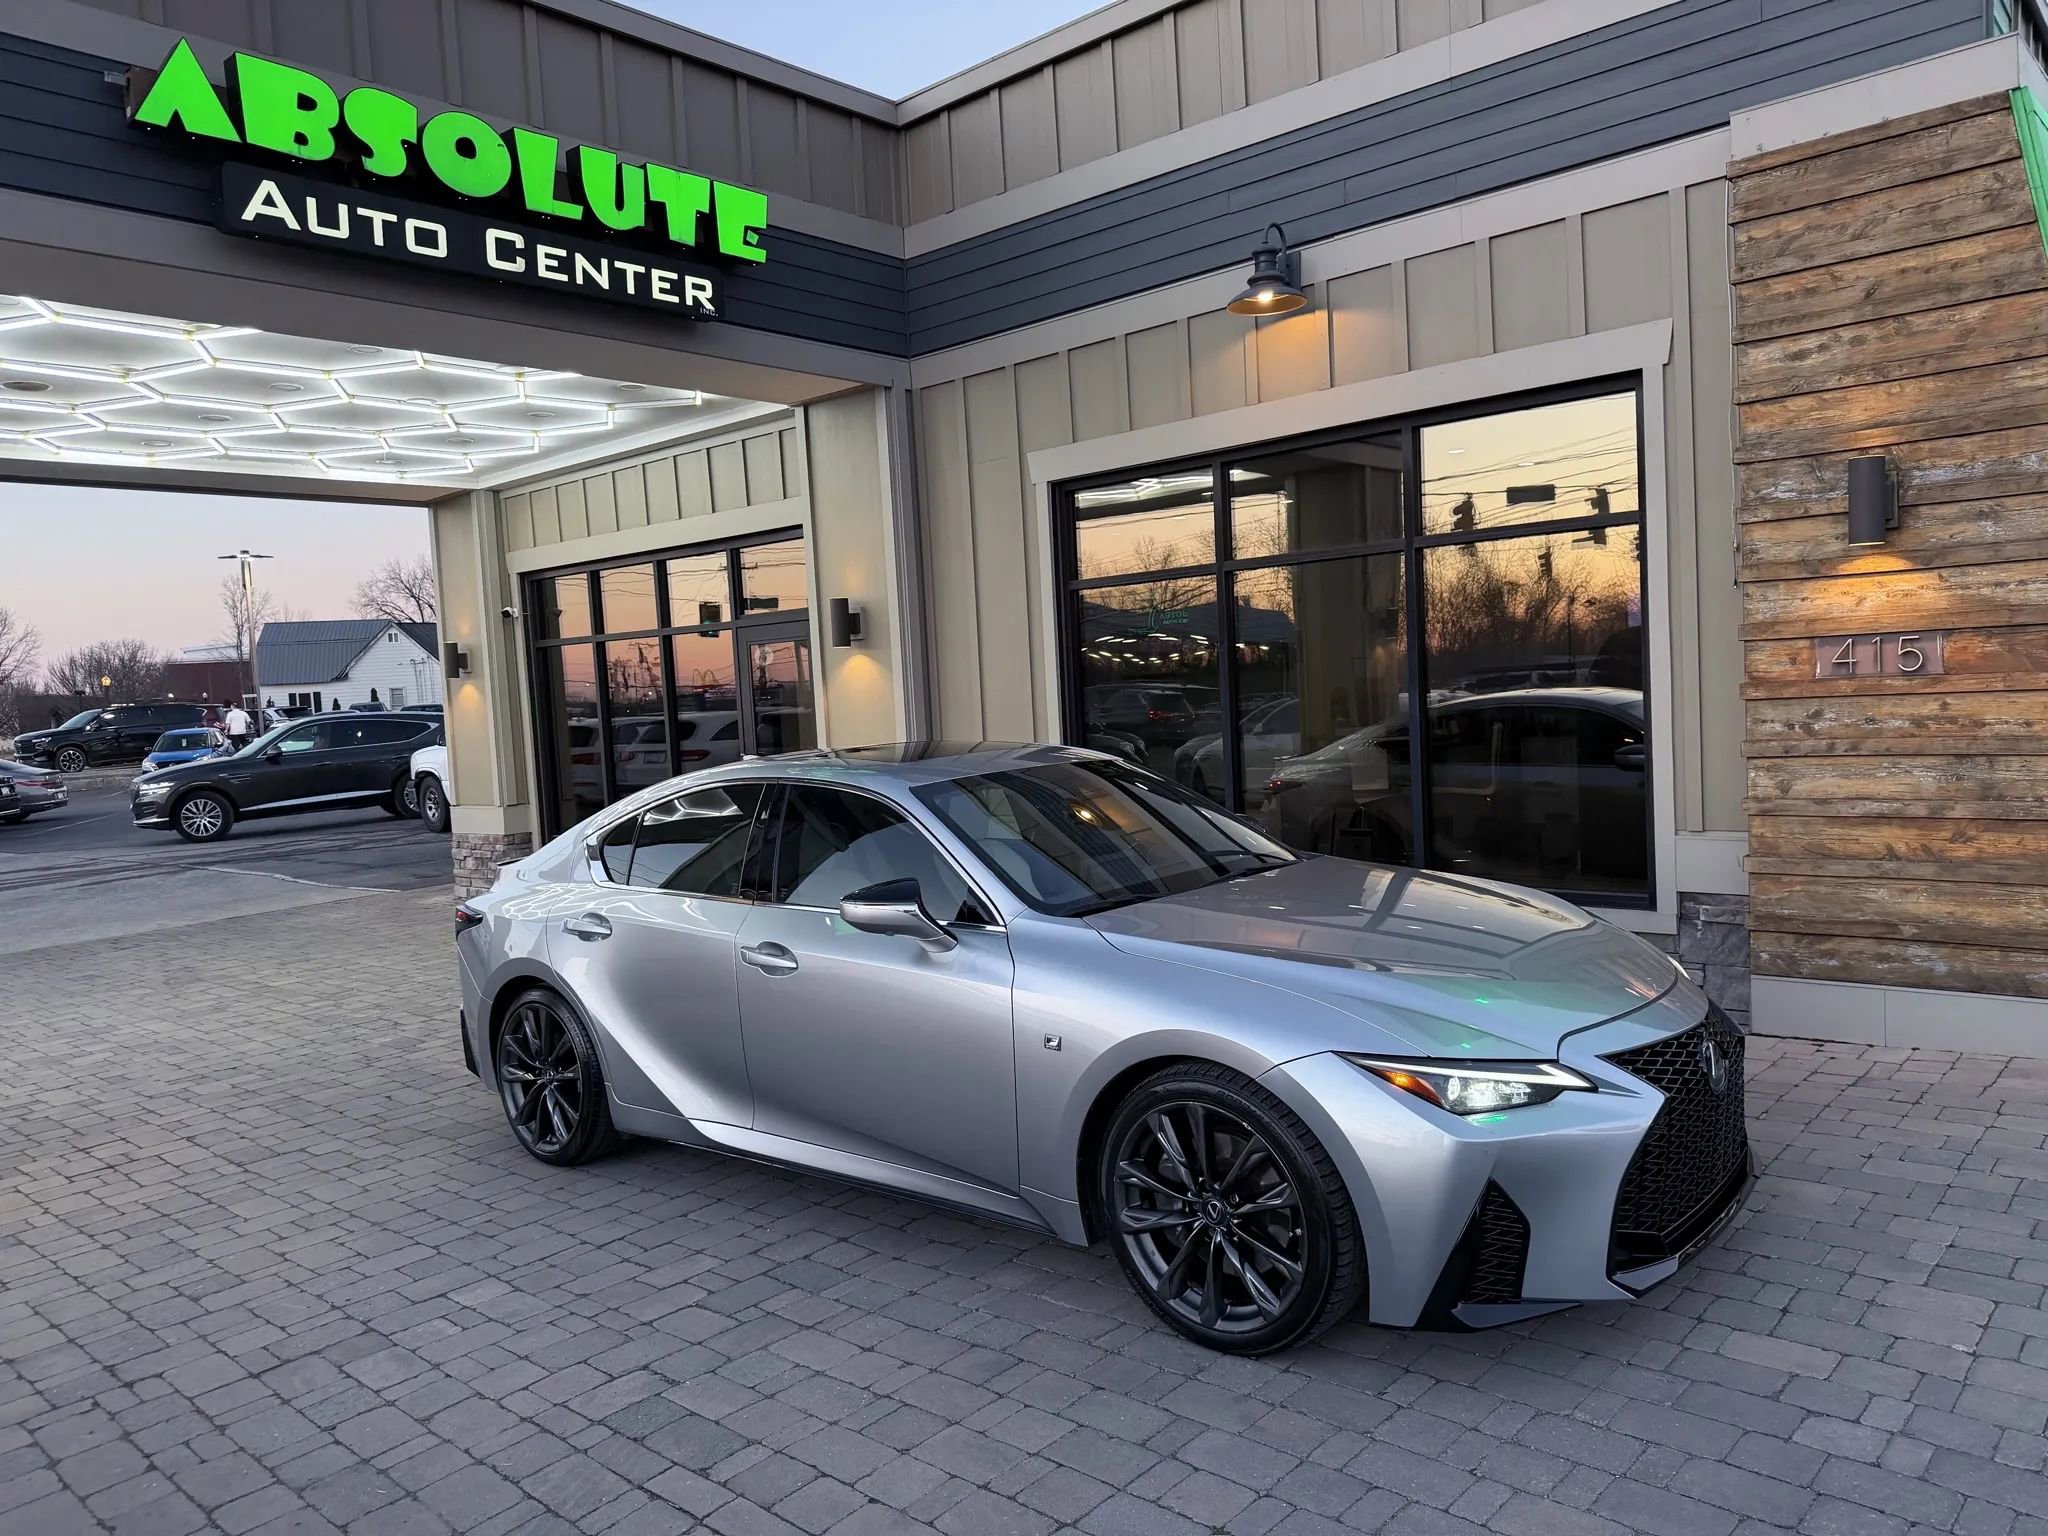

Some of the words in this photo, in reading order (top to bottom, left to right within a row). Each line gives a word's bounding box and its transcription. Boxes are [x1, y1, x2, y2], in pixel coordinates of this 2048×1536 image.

[135, 37, 768, 263] ABSOLUTE
[241, 179, 448, 258] AUTO
[485, 227, 715, 310] CENTER
[1831, 635, 1923, 673] 415
